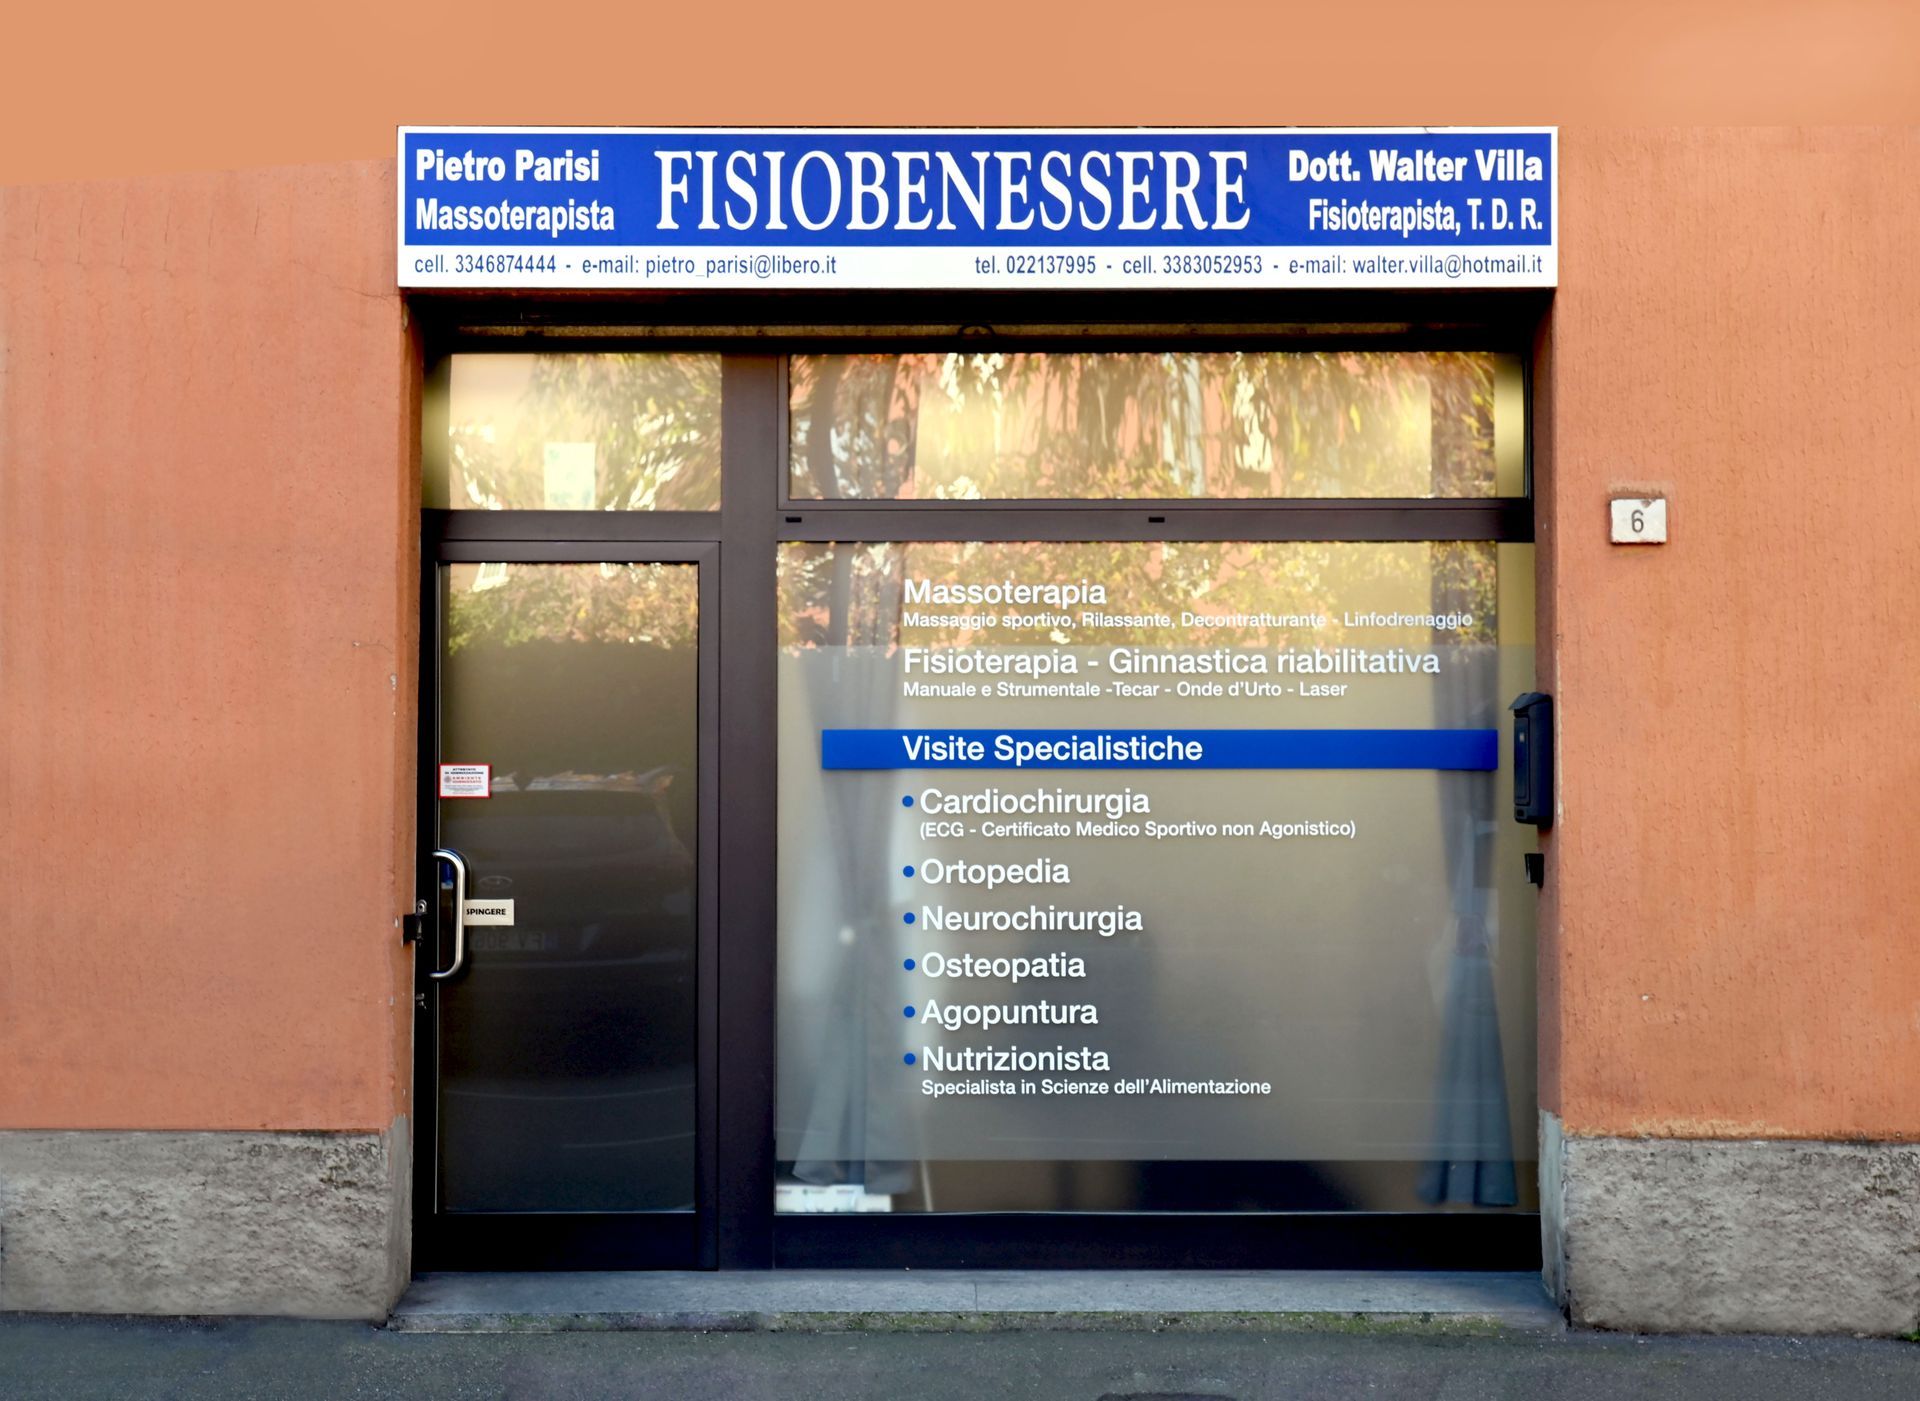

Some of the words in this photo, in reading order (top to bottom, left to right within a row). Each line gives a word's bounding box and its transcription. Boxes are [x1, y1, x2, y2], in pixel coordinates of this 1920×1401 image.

[416, 149, 506, 182] Pietro
[515, 149, 599, 182] Parisi
[1288, 149, 1361, 182] Dott.
[1369, 149, 1468, 182] Walter
[1474, 149, 1543, 182] Villa
[654, 150, 1251, 231] FISIOBENESSERE
[416, 198, 615, 238] Massoterapista
[1309, 198, 1461, 239] Fisioterapista,
[1467, 198, 1485, 230] T.
[1491, 198, 1514, 230] D.
[1520, 198, 1543, 230] R.
[414, 254, 449, 274] cell.
[455, 254, 557, 274] 3346874444
[582, 254, 639, 274] e-mail:
[646, 254, 837, 279] pietro_parisi@libero.it
[975, 255, 1000, 274] tel.
[1006, 255, 1096, 274] 022137995
[1122, 255, 1157, 274] cell.
[1163, 255, 1263, 274] 3383052953
[1289, 255, 1346, 274] e-mail:
[1352, 255, 1542, 279] walter.villa@hotmail.it
[1630, 509, 1645, 533] 6
[903, 579, 1107, 609] Massoterapia
[903, 612, 996, 631] Massaggio
[1002, 612, 1077, 630] sportivo,
[1082, 612, 1176, 630] Rilassante,
[1181, 612, 1327, 628] Decontratturante
[1344, 612, 1473, 630] Linfodrenaggio
[904, 648, 1079, 679] Fisioterapia
[1108, 647, 1269, 674] Ginnastica
[1277, 647, 1441, 674] riabilitativa
[903, 681, 977, 697] Manuale
[981, 685, 992, 697] e
[996, 681, 1101, 697] Strumentale
[1105, 681, 1161, 697] -Tecar
[1176, 681, 1224, 697] Onde
[1228, 681, 1282, 697] d’Urto
[1299, 681, 1348, 697] Laser
[902, 735, 985, 761] Visite
[994, 734, 1203, 767] Specialistiche
[919, 787, 1151, 819] Cardiochirurgia
[919, 821, 964, 841] (ECG
[981, 821, 1071, 837] Certificato
[1076, 821, 1140, 837] Medico
[1144, 820, 1218, 840] Sportivo
[1223, 823, 1255, 836] non
[1258, 819, 1356, 840] Agonistico)
[919, 857, 1071, 890] Ortopedia
[466, 908, 507, 916] SPINGERE
[920, 904, 1144, 937] Neurochirurgia
[920, 951, 1086, 983] Osteopatia
[921, 998, 1099, 1031] Agopuntura
[921, 1045, 1110, 1072] Nutrizionista
[921, 1078, 1017, 1099] Specialista
[1021, 1079, 1036, 1095] in
[1041, 1078, 1109, 1095] Scienze
[1114, 1078, 1272, 1095] dell’Alimentazione
